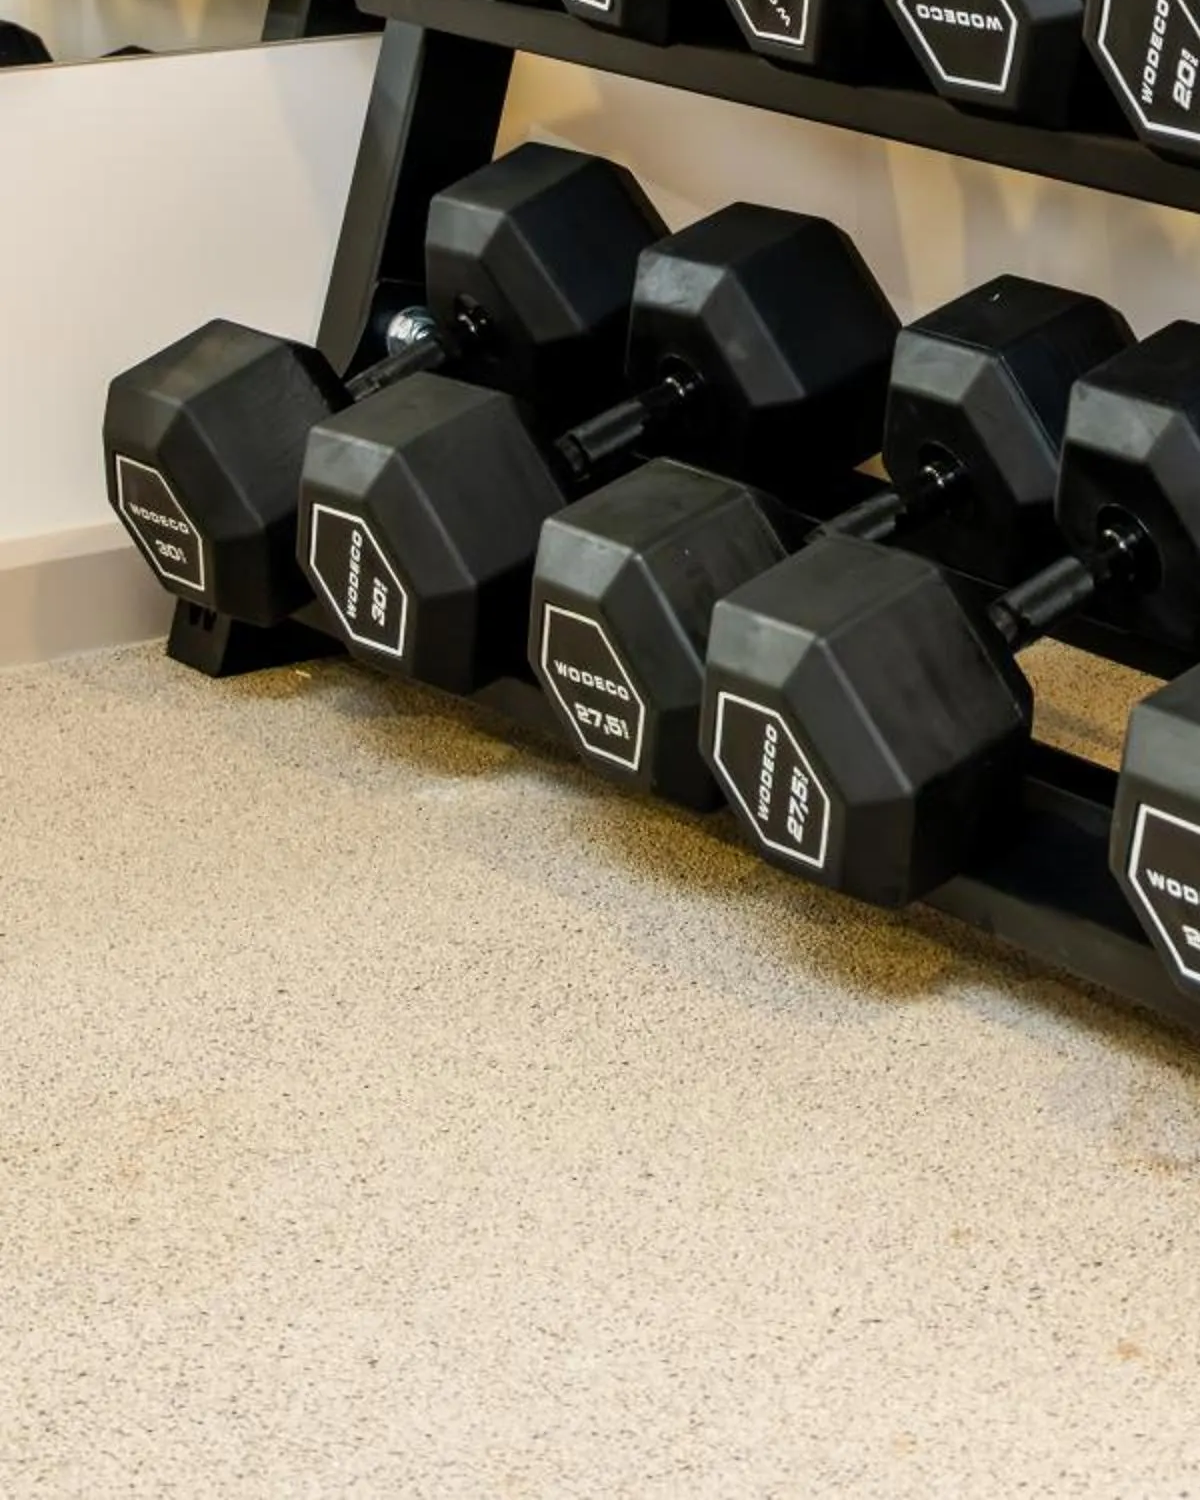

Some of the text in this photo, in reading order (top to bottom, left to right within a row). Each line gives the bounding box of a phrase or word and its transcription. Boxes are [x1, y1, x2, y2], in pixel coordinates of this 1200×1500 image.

[916, 3, 1003, 32] WODECO
[347, 529, 363, 619] WODECO
[554, 659, 629, 701] WODECO
[757, 723, 778, 821] WODECO
